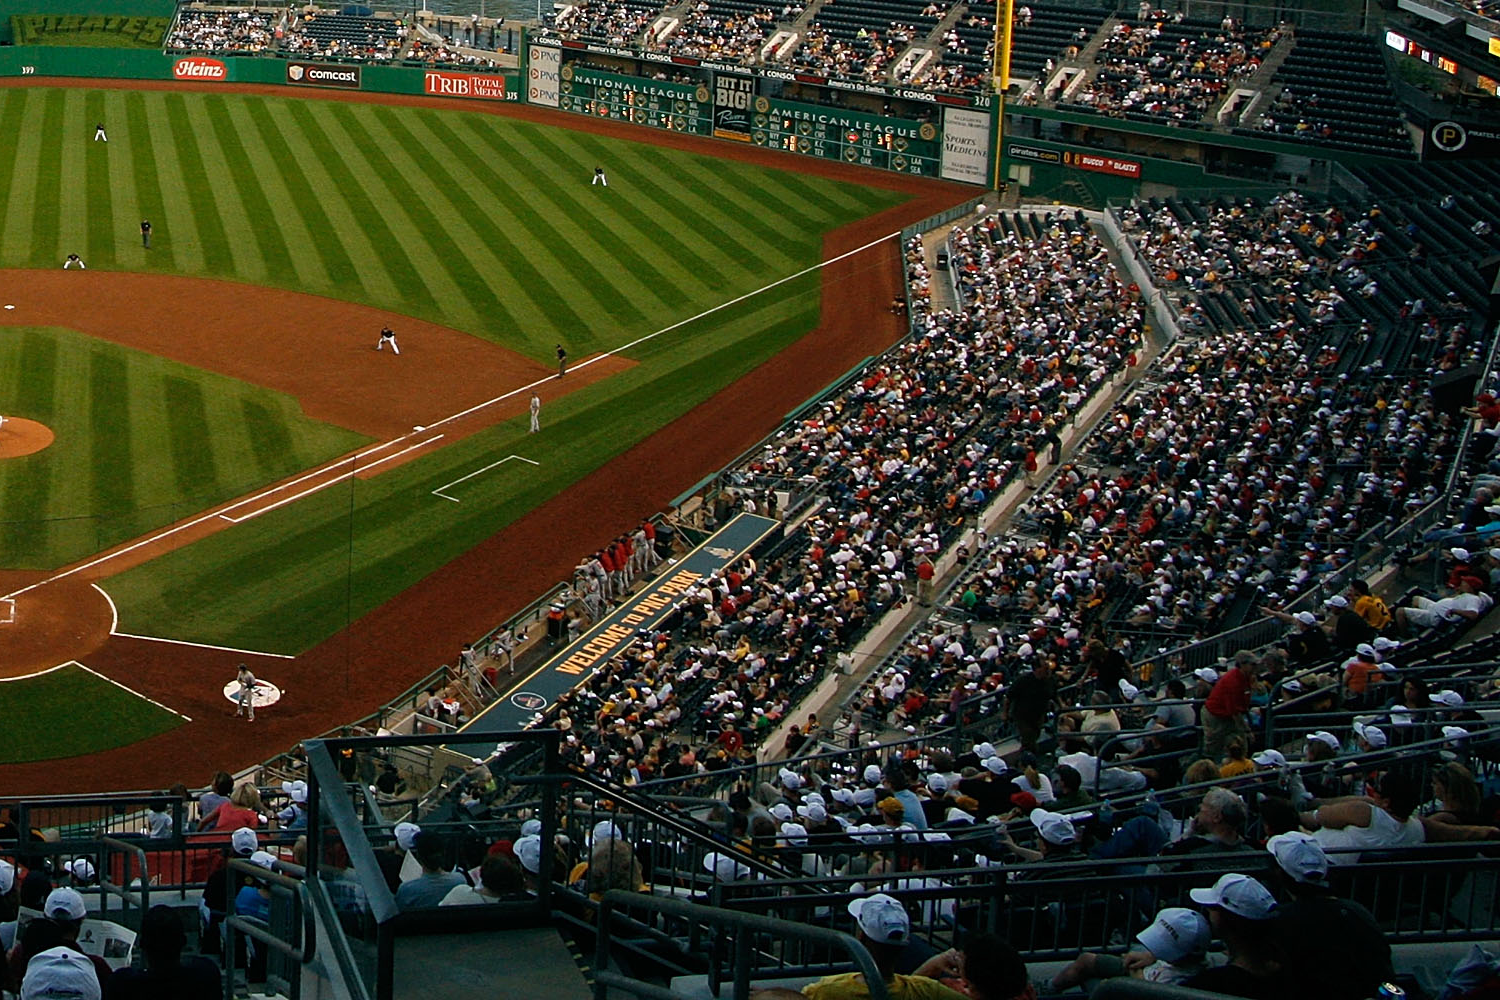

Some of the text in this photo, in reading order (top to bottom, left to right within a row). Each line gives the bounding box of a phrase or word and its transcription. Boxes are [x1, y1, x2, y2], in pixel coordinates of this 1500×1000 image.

[539, 37, 563, 46] CONSOL
[540, 51, 560, 62] PNC
[646, 53, 673, 63] CONSOL
[175, 60, 223, 77] Heinz
[700, 60, 752, 74] America's On Switch
[307, 67, 357, 83] comcast
[540, 71, 560, 83] PNC
[766, 70, 797, 81] CONSOL
[425, 73, 469, 95] TRIB
[472, 77, 502, 88] TOTAL
[575, 75, 693, 101] NATIONAL LEAGUE
[716, 75, 752, 92] HIT IT
[827, 79, 886, 94] America's On Switch
[474, 86, 503, 97] MEDIA
[506, 91, 518, 100] 375
[539, 89, 559, 102] PNC
[902, 90, 937, 102] CONSOL
[974, 95, 990, 107] 320
[771, 107, 850, 127] AMERICAN
[855, 121, 917, 139] LEAGUE
[945, 133, 976, 146] SPORTS
[1442, 128, 1456, 144] P
[945, 143, 988, 157] MEDICINE
[1010, 147, 1058, 161] pirates.com
[1063, 151, 1080, 165] 0 8
[1082, 157, 1104, 167] BUCCO
[555, 569, 703, 675] WELCOME TO PNC PARK
